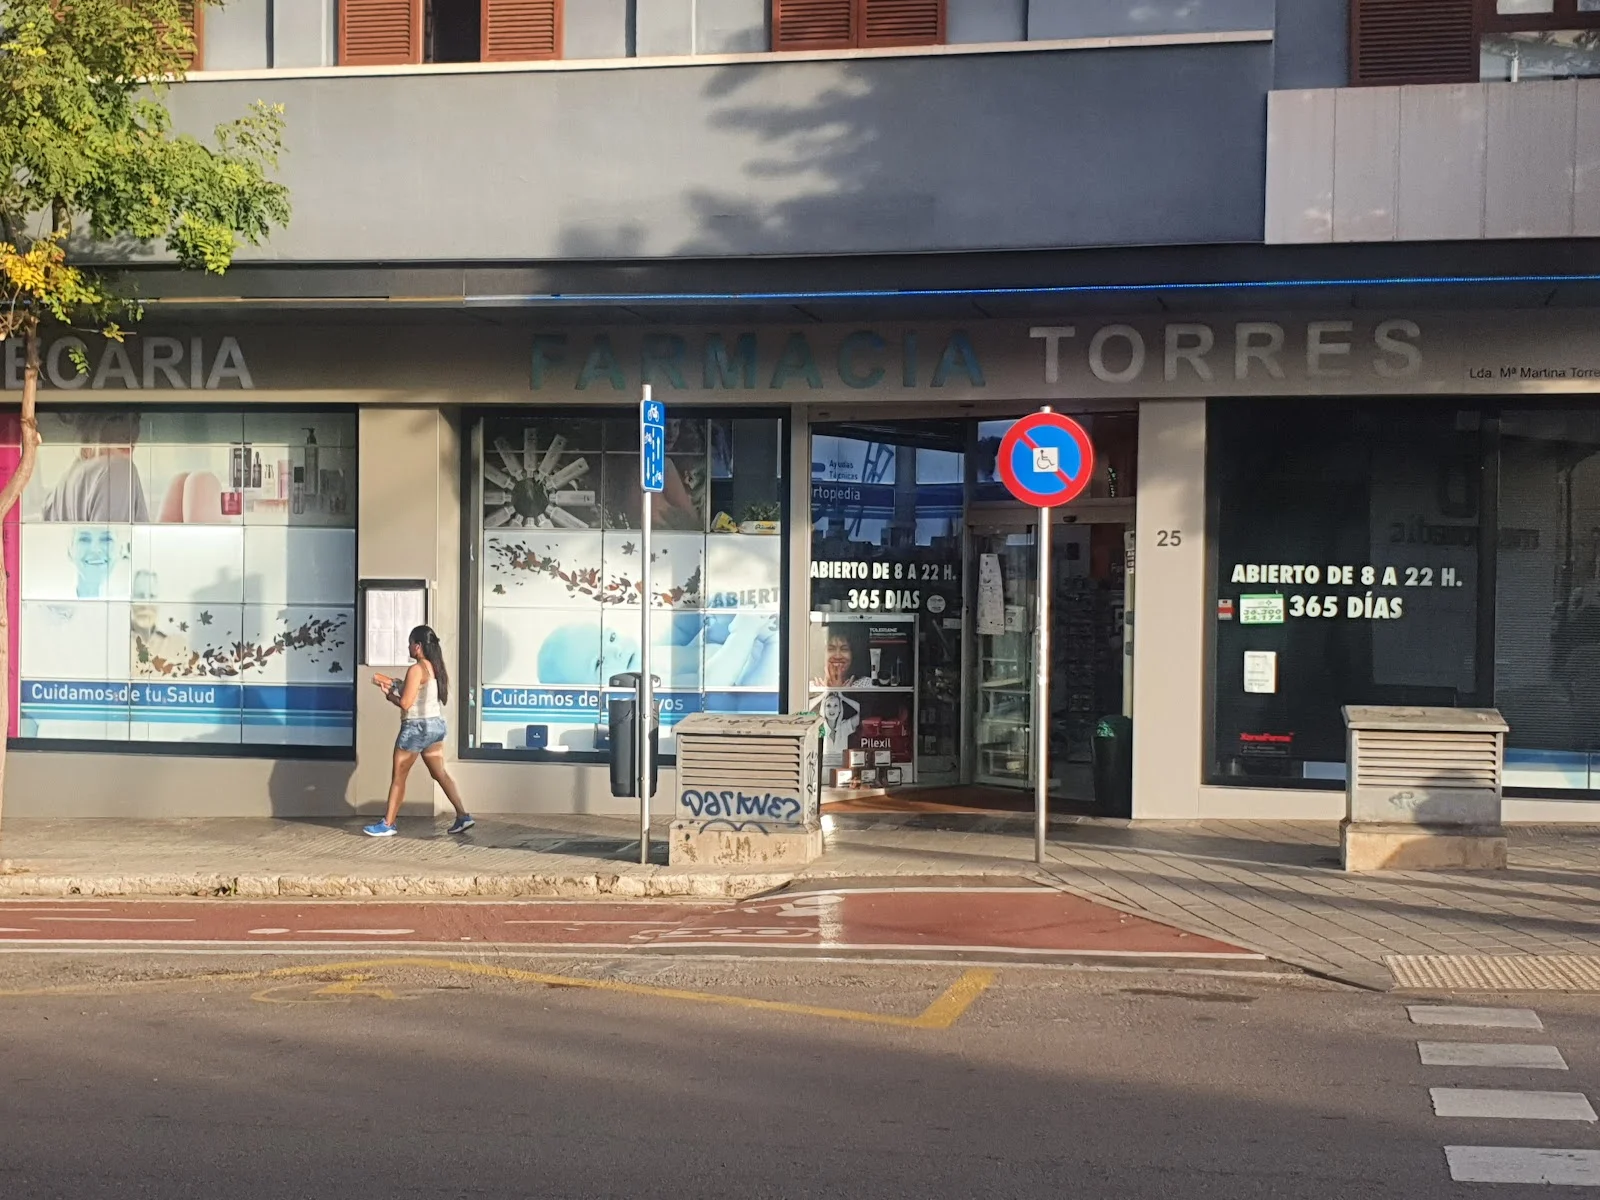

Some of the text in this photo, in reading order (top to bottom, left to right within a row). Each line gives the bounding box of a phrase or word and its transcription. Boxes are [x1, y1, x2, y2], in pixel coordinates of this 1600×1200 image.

[5, 336, 253, 389] ECARIA
[529, 318, 1423, 391] FARMACIA TORRES
[1519, 367, 1566, 378] Martina
[813, 485, 861, 502] rtopedia
[1157, 530, 1182, 547] 25
[810, 560, 957, 580] ABIERTO DE 8 A 22 H.
[1231, 564, 1463, 587] ABIERTO DE 8 A 22 H.
[847, 589, 880, 609] 365
[1289, 591, 1403, 618] 365 DÍAS
[31, 683, 215, 704] Cuidamos de tu Salud
[491, 689, 574, 706] Cuidamos
[578, 690, 598, 707] de
[861, 738, 891, 748] Pilexil
